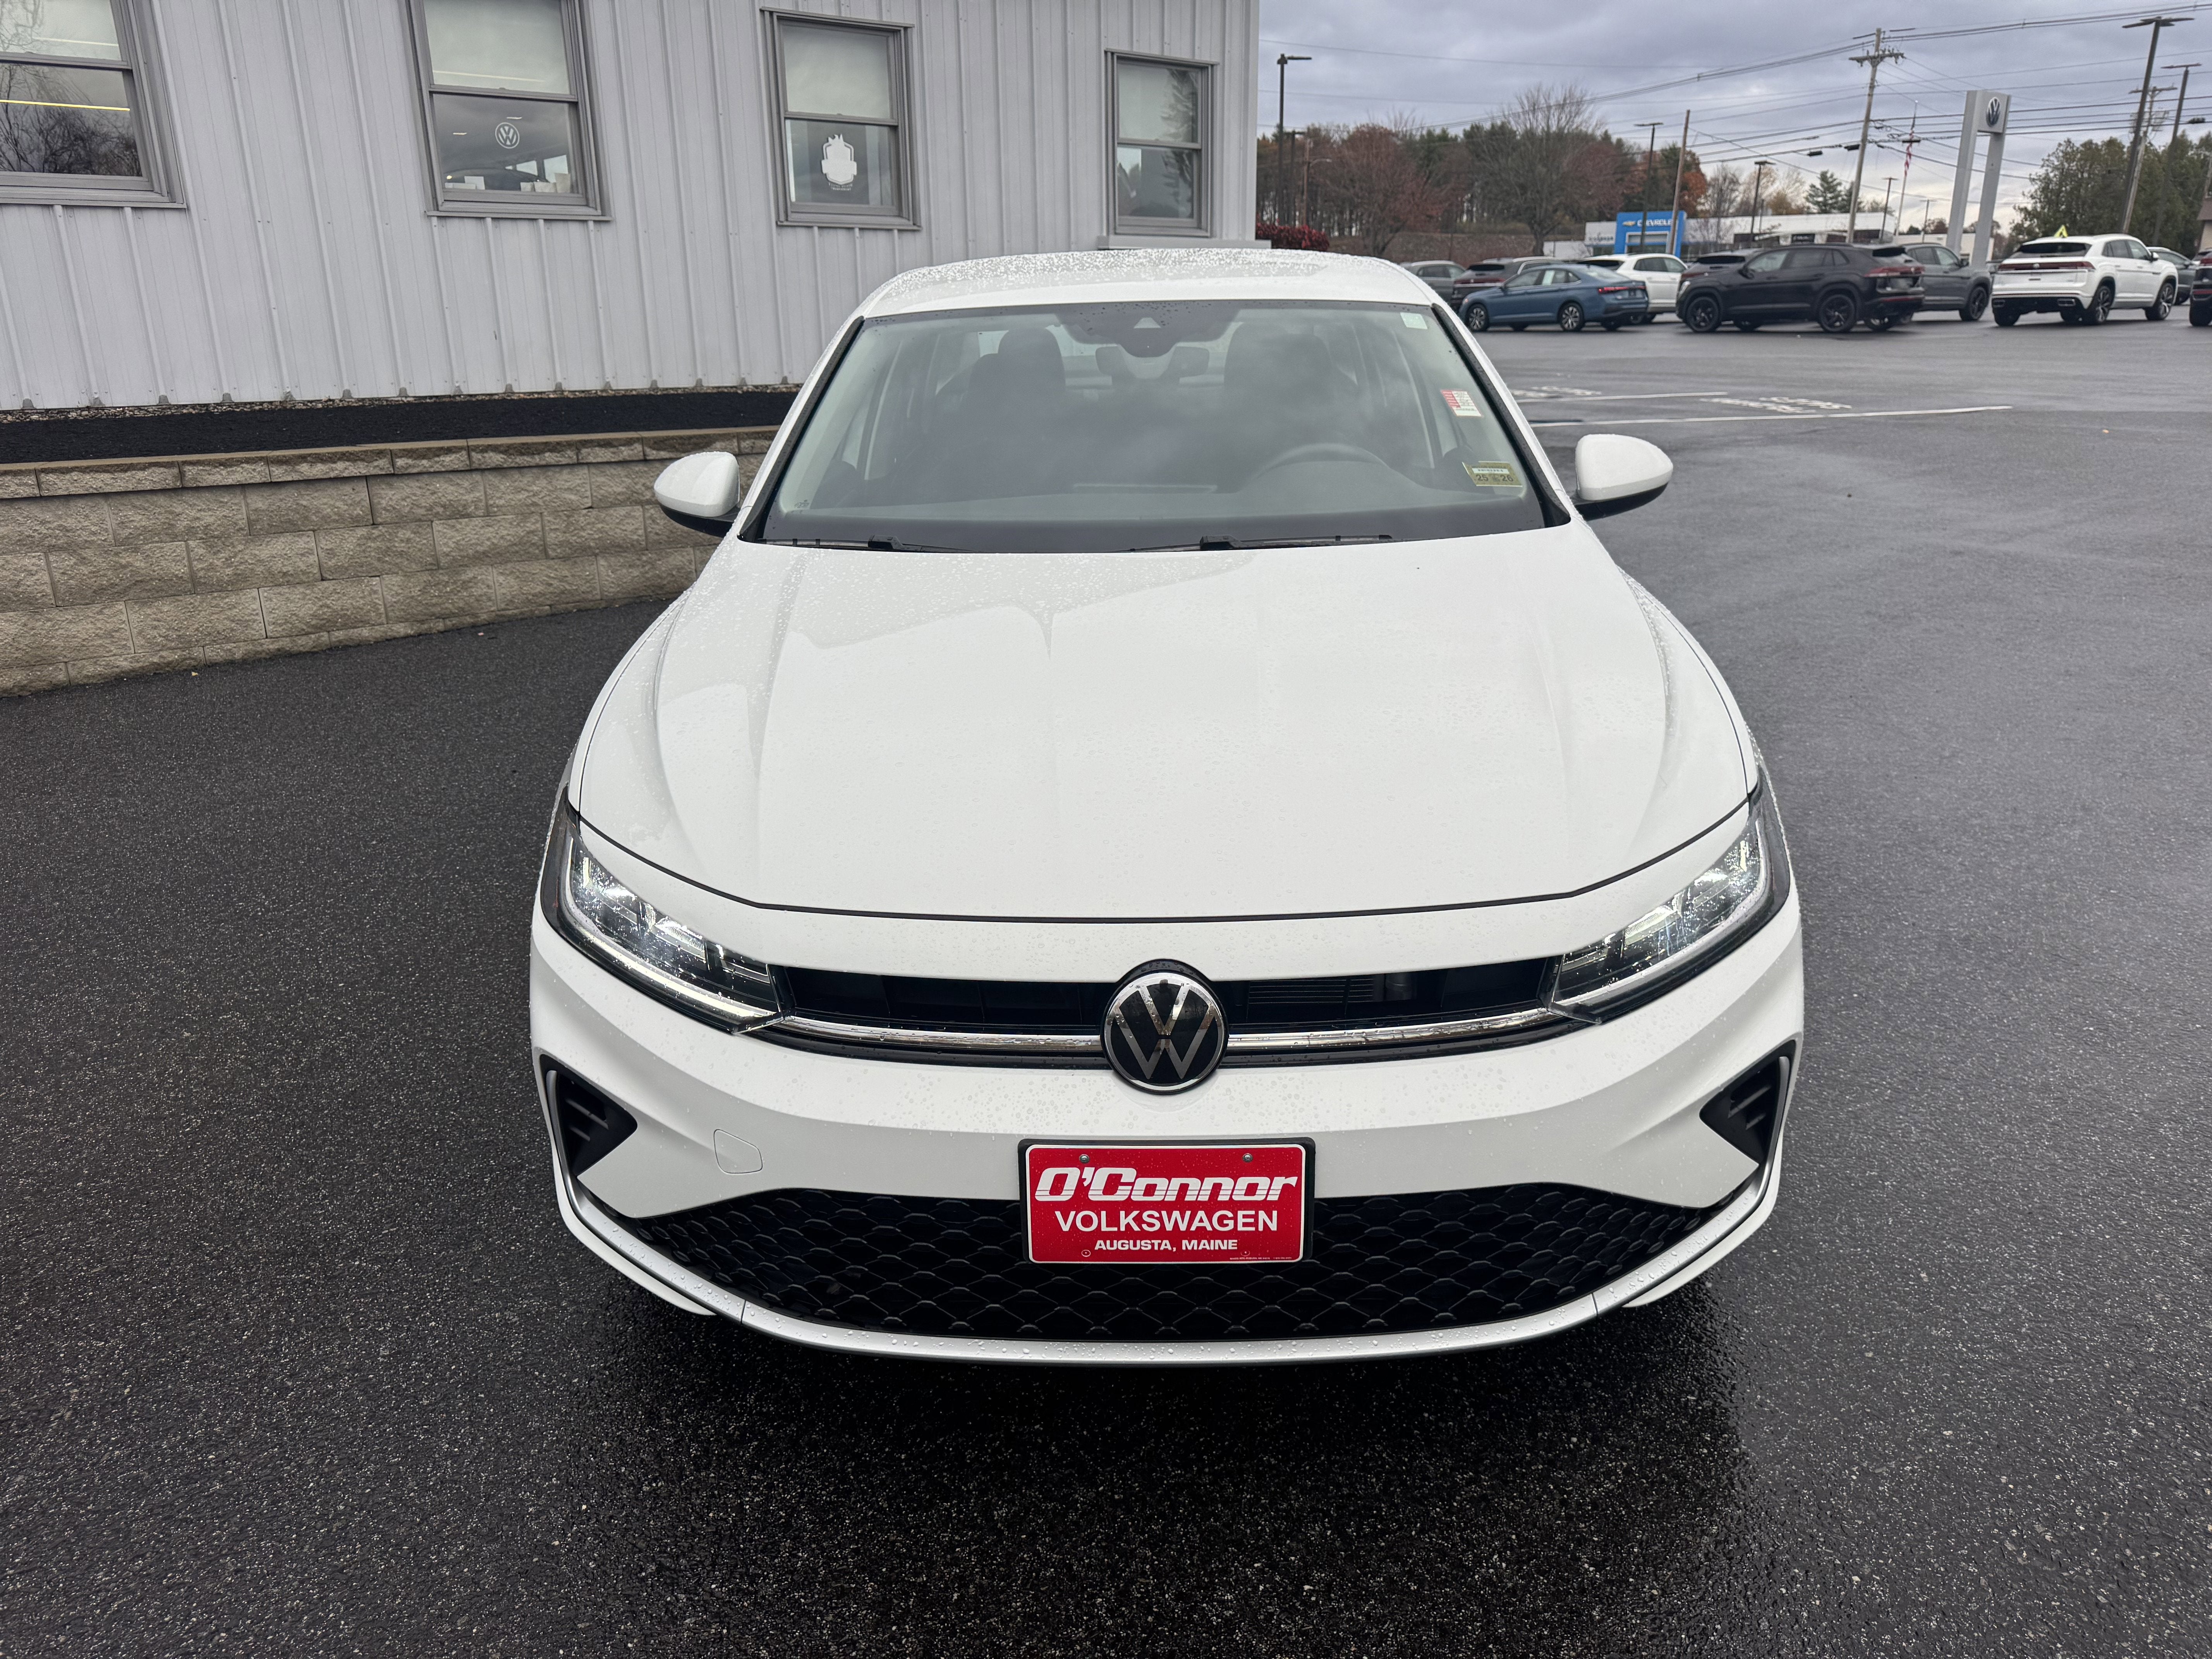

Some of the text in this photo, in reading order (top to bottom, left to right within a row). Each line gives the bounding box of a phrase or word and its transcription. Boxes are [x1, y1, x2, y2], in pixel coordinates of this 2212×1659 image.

[1637, 219, 1674, 227] CEVROLE
[1035, 1167, 1298, 1201] O'Connor
[1055, 1210, 1278, 1231] VOLKSWAGEN
[1094, 1240, 1238, 1252] AUGUSTA, MAINE
